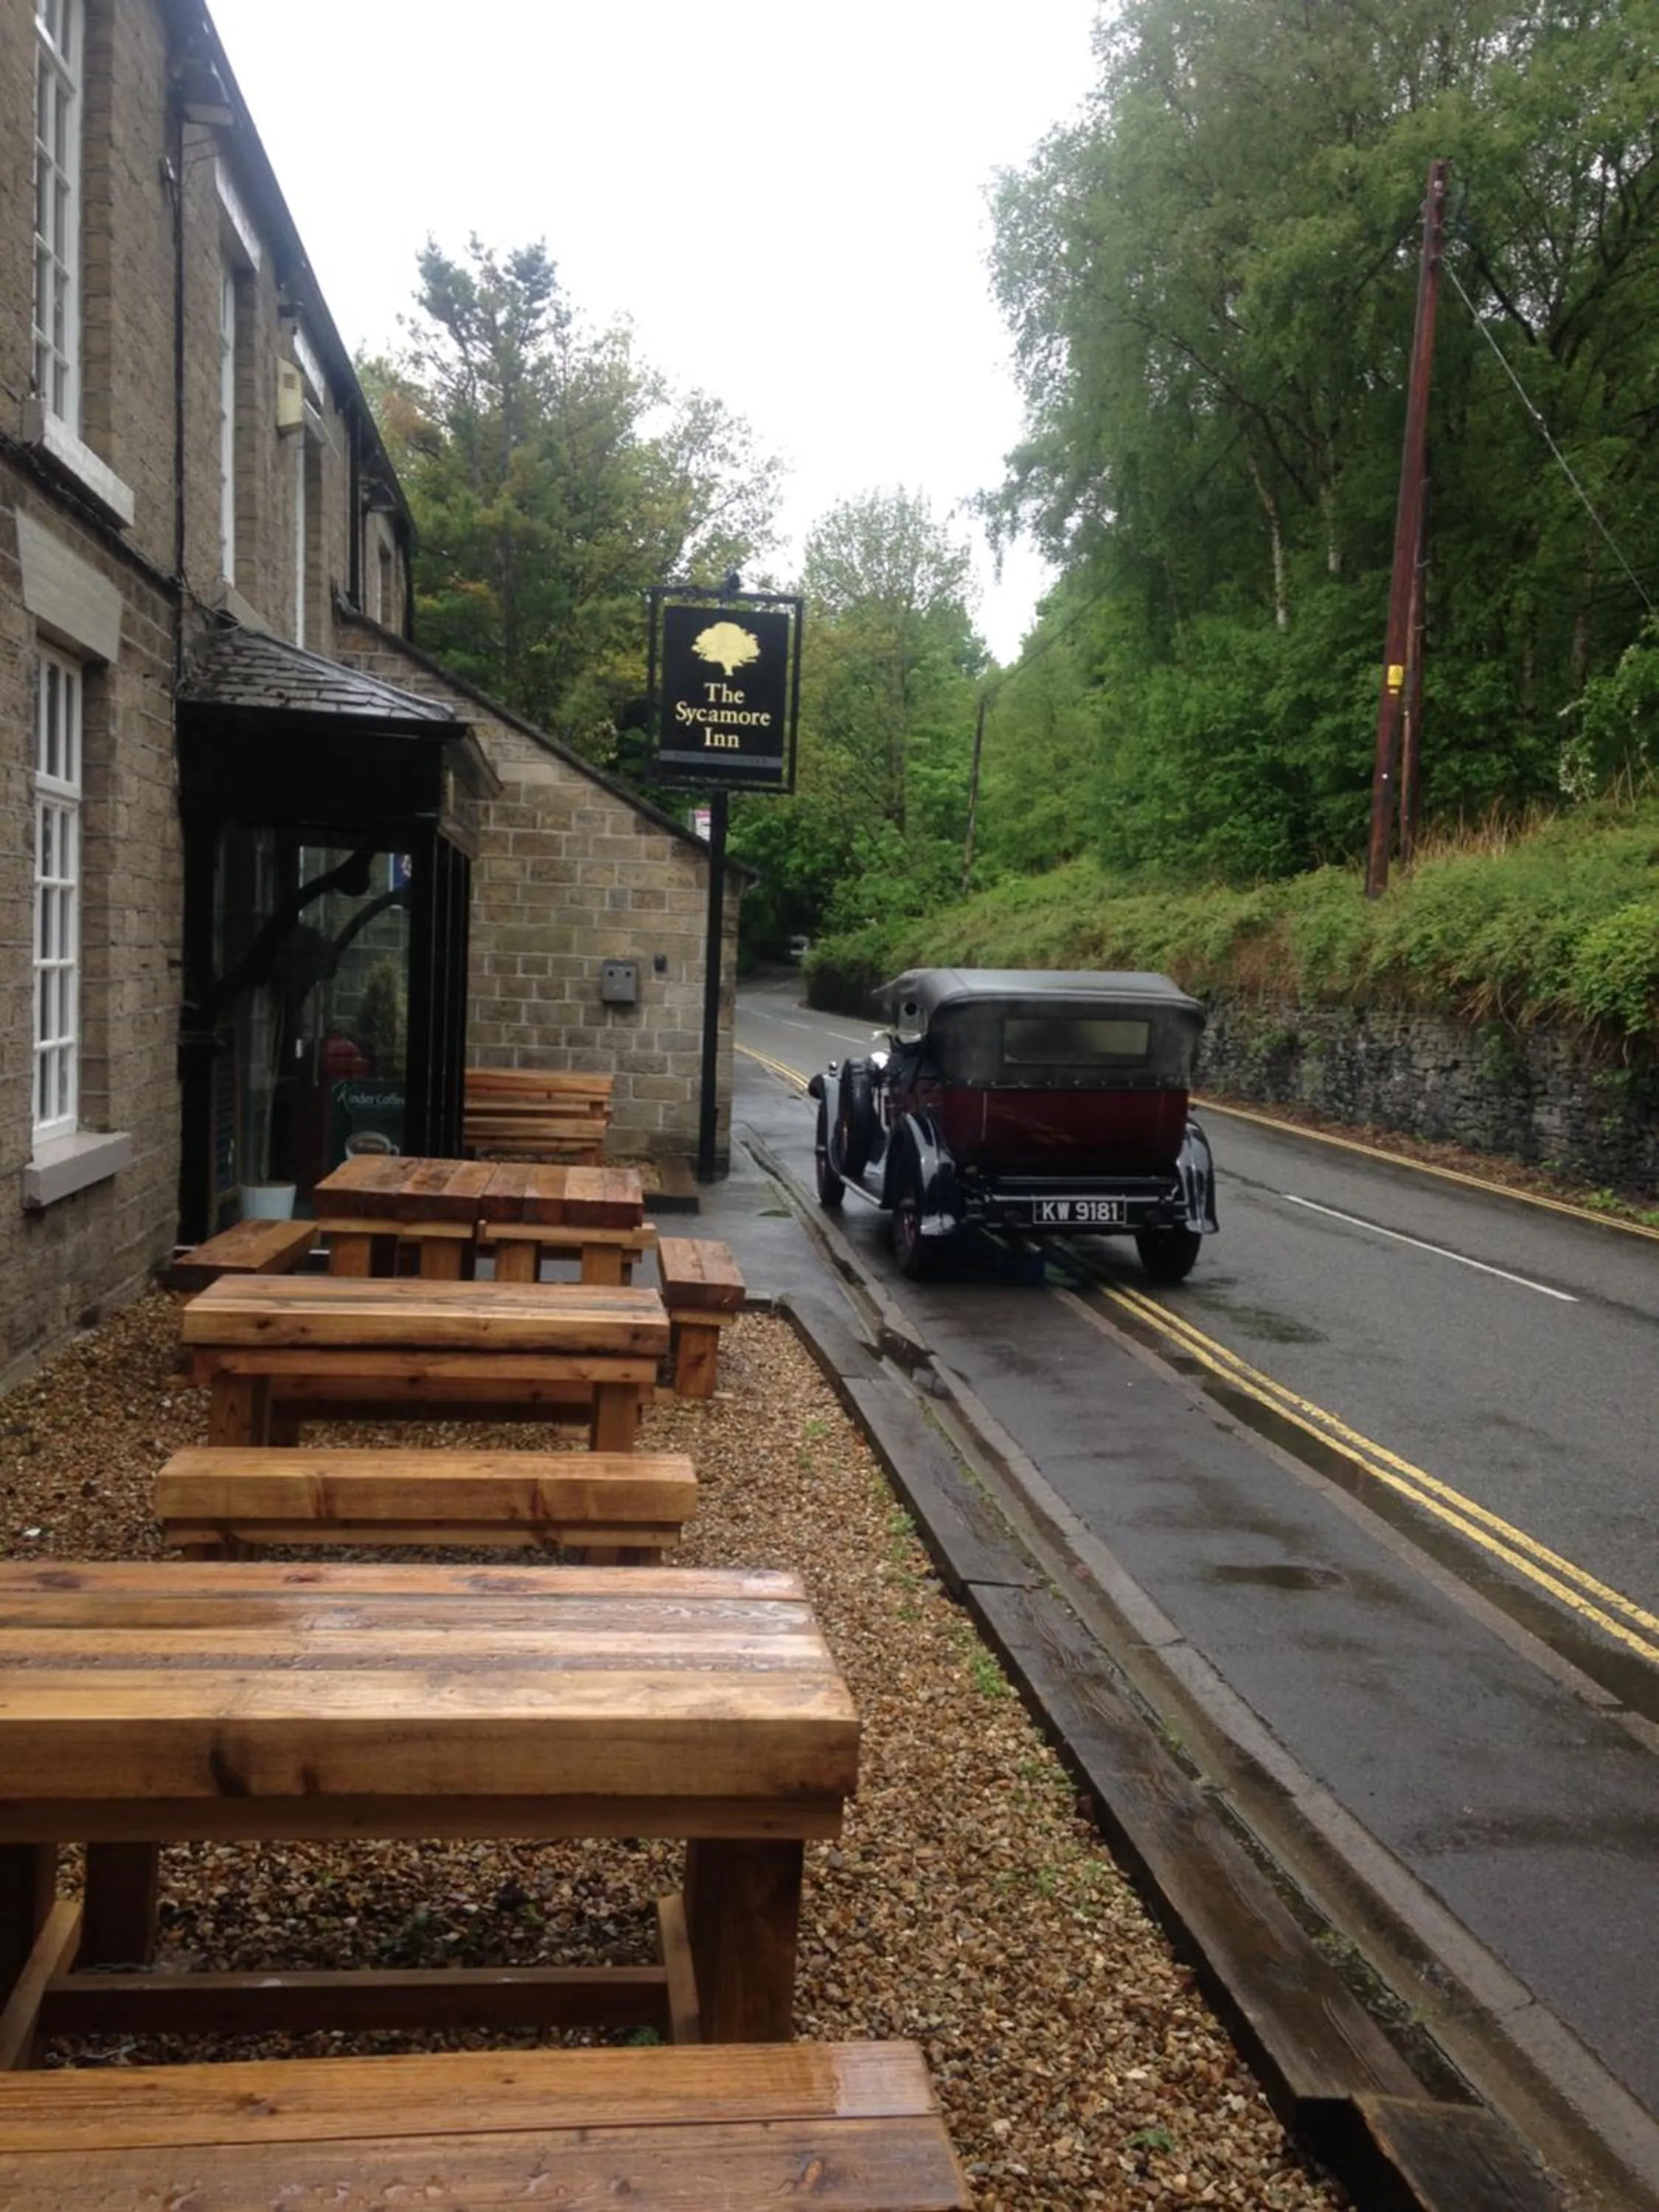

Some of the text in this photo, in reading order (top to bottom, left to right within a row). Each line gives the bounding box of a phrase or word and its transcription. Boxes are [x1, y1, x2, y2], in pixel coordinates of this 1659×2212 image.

[704, 682, 745, 703] The
[675, 701, 771, 726] Sycamore
[704, 727, 740, 748] Inn
[1043, 1202, 1117, 1220] KW 9181
